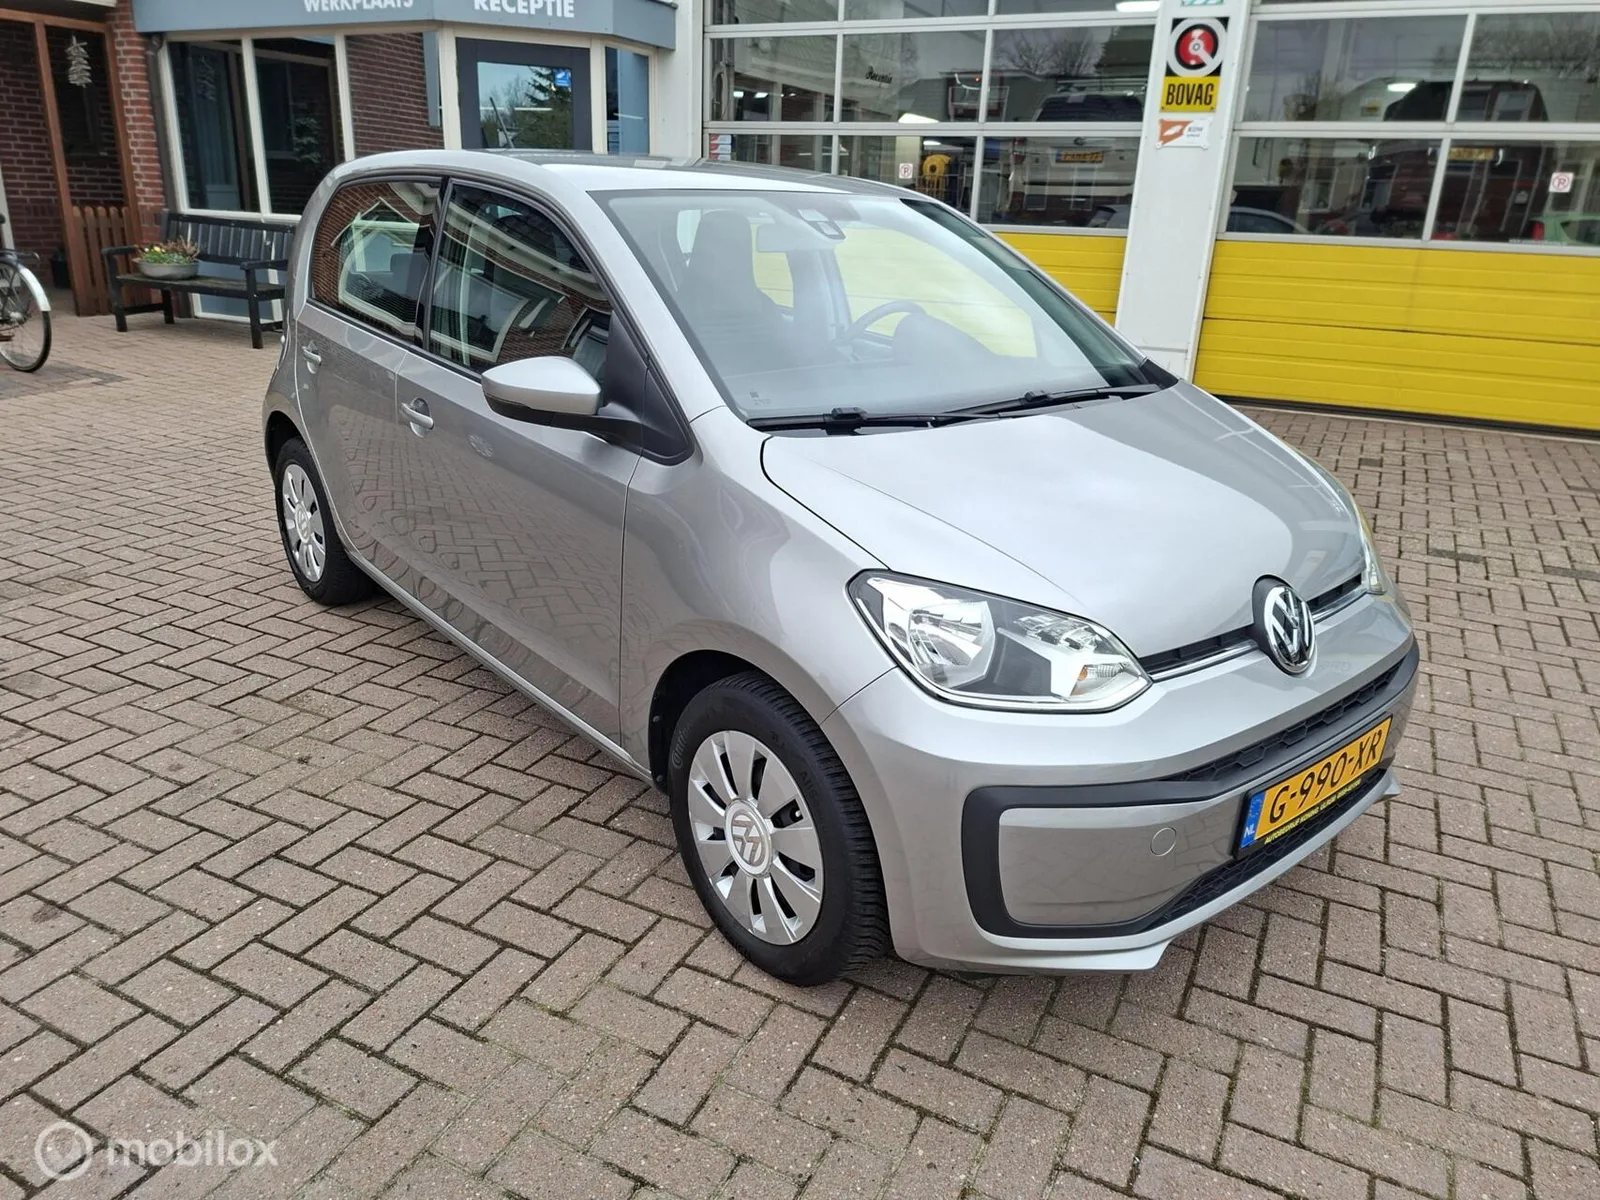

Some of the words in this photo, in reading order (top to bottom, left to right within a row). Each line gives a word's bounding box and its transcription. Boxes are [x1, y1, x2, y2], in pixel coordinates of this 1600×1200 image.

[474, 0, 575, 18] RECEPTIE
[1165, 82, 1215, 106] BOVAG
[1268, 728, 1383, 825] G-990-XR
[1243, 823, 1255, 839] NL
